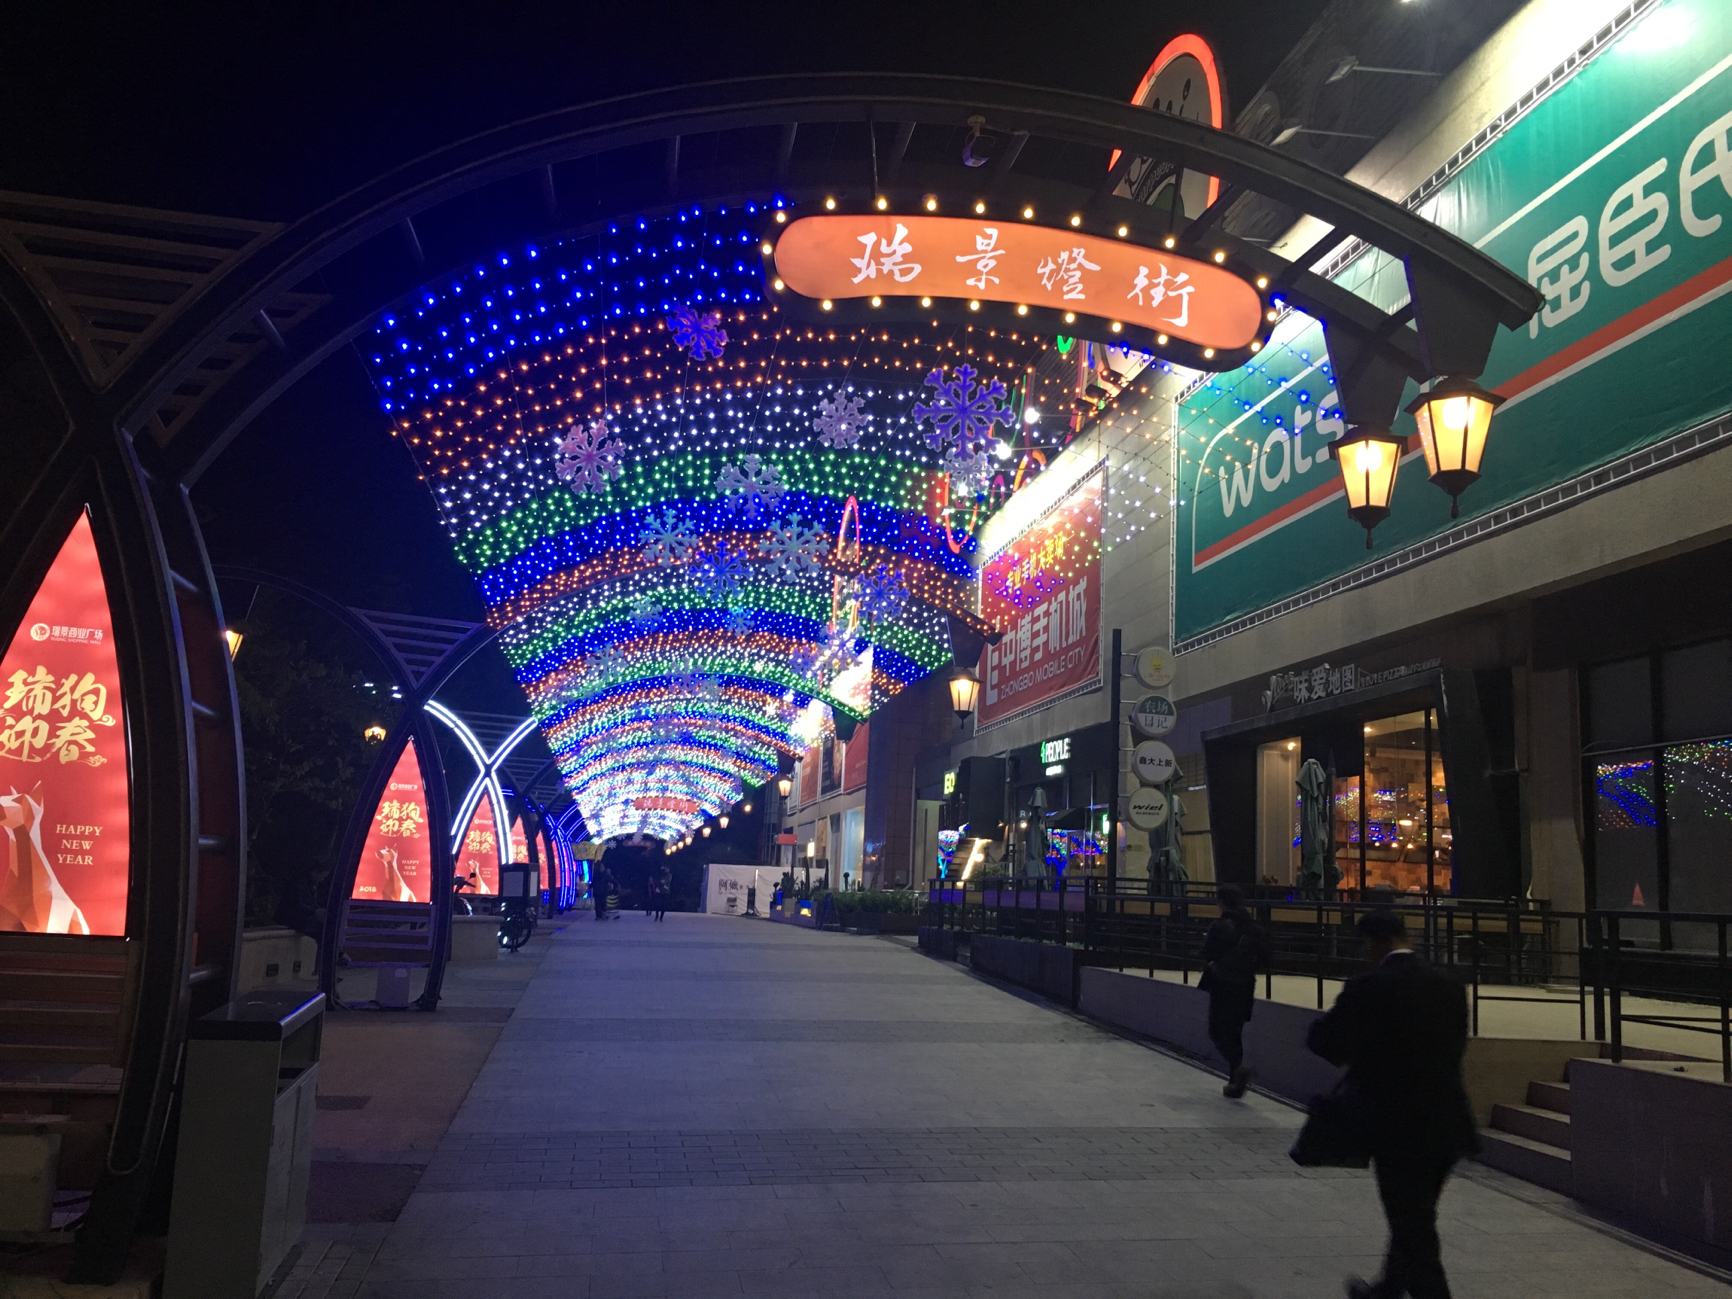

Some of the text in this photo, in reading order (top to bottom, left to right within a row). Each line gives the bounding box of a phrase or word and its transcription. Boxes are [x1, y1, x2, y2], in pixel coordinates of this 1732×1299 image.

[51, 625, 103, 641] 瑞景商业广场
[1002, 576, 1088, 677] 中博手机城
[1001, 644, 1086, 700] ZHONGBO MOBILE CITY
[1293, 663, 1355, 704] 味爱地图
[56, 824, 103, 836] HAPPY
[61, 839, 94, 850] NEW
[57, 853, 94, 866] YEAR
